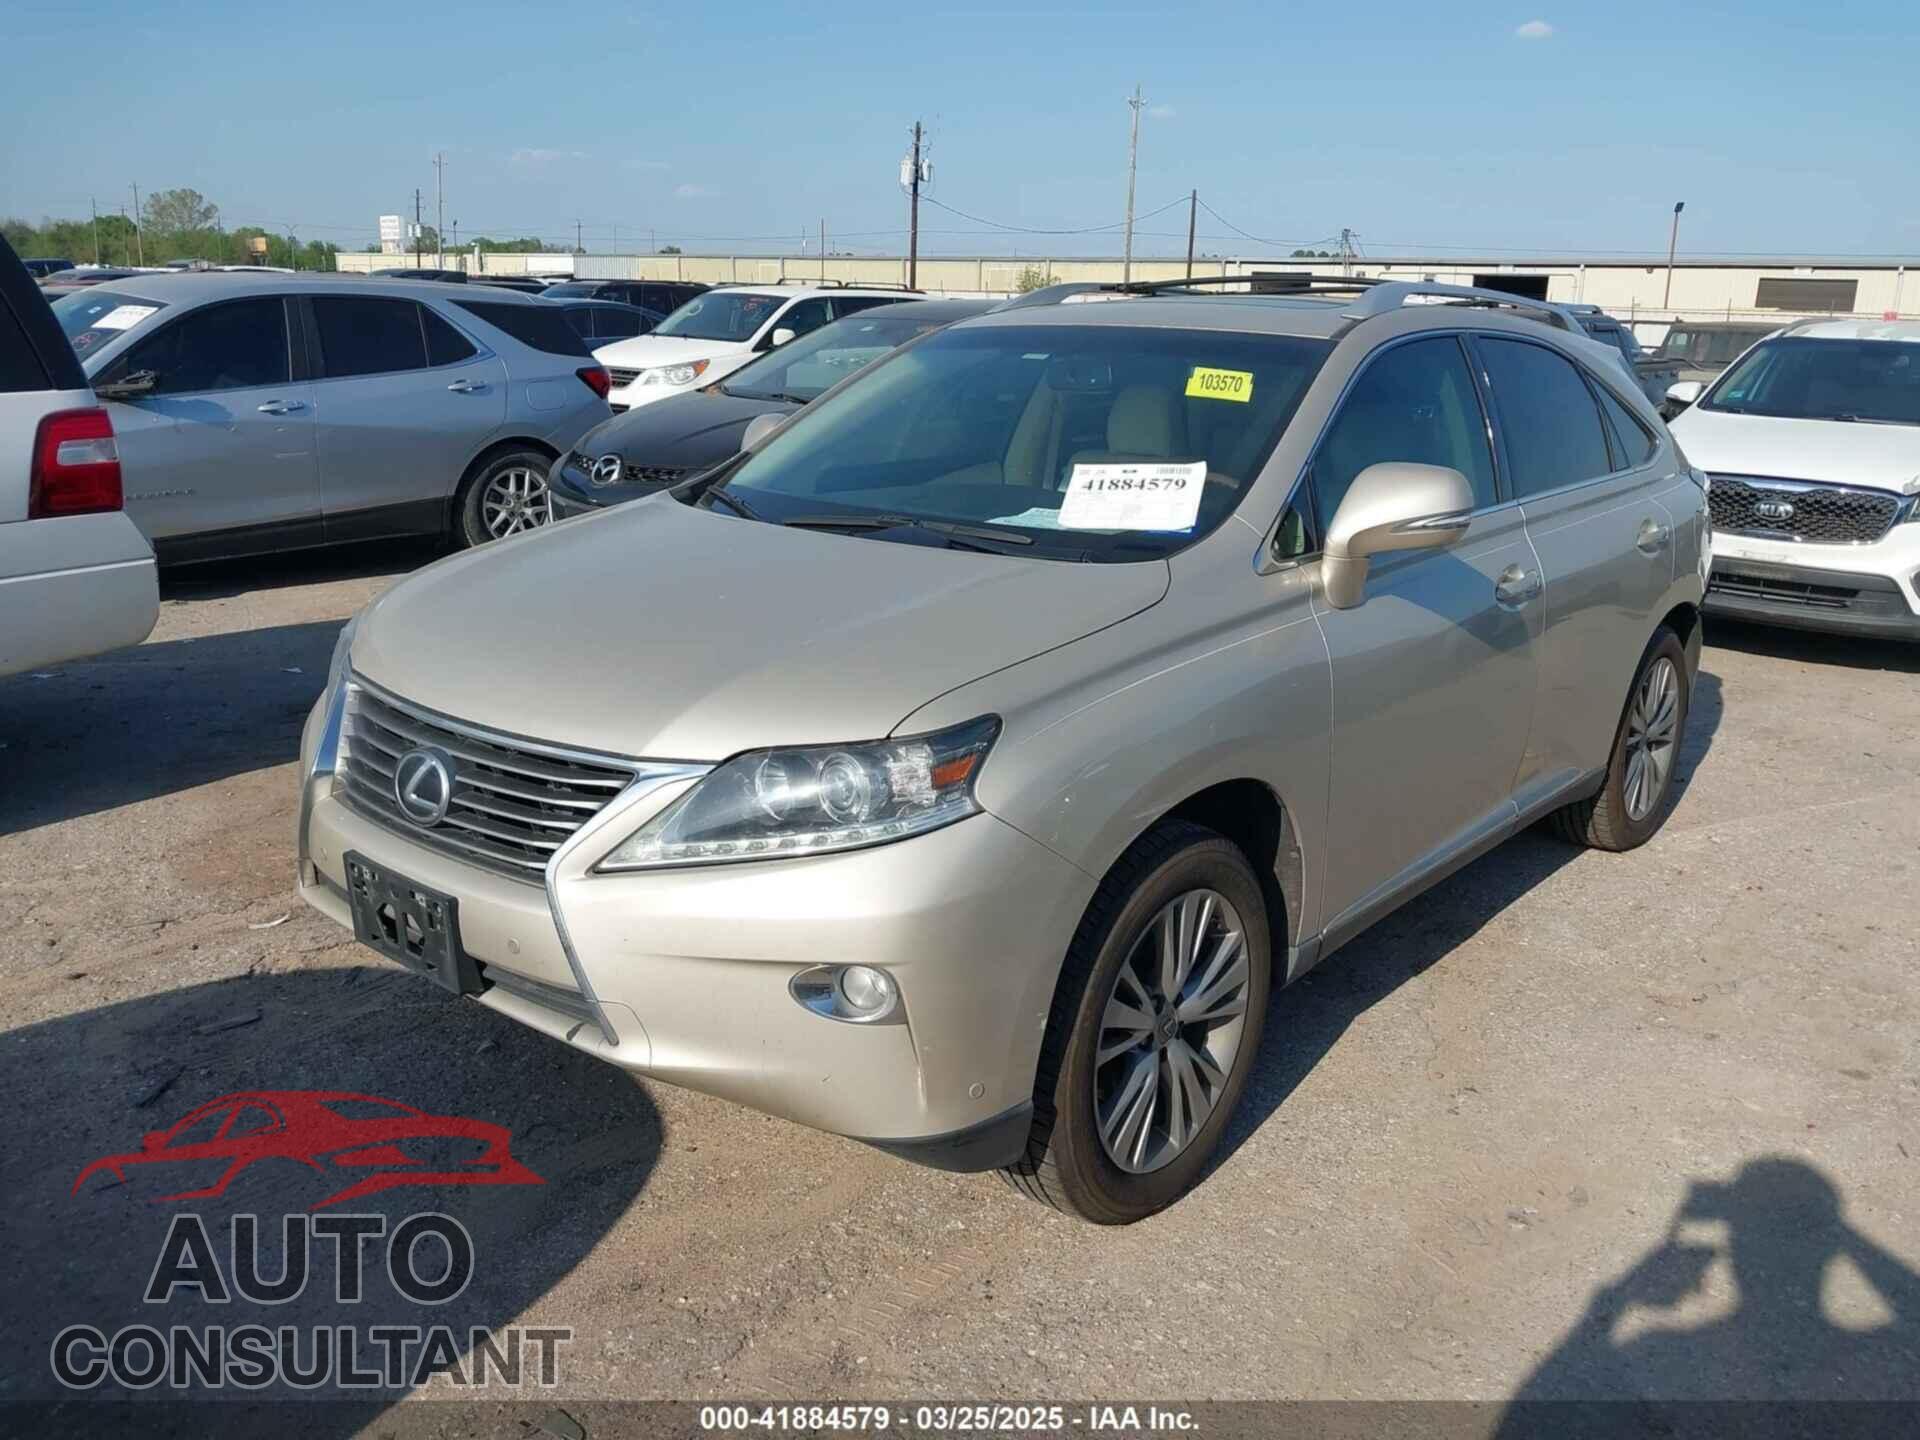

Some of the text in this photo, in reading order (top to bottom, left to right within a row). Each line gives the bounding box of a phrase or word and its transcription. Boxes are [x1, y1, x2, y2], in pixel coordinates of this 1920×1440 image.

[1200, 373, 1244, 393] 103570
[1081, 478, 1187, 491] 41884579
[1759, 503, 1793, 517] KIA
